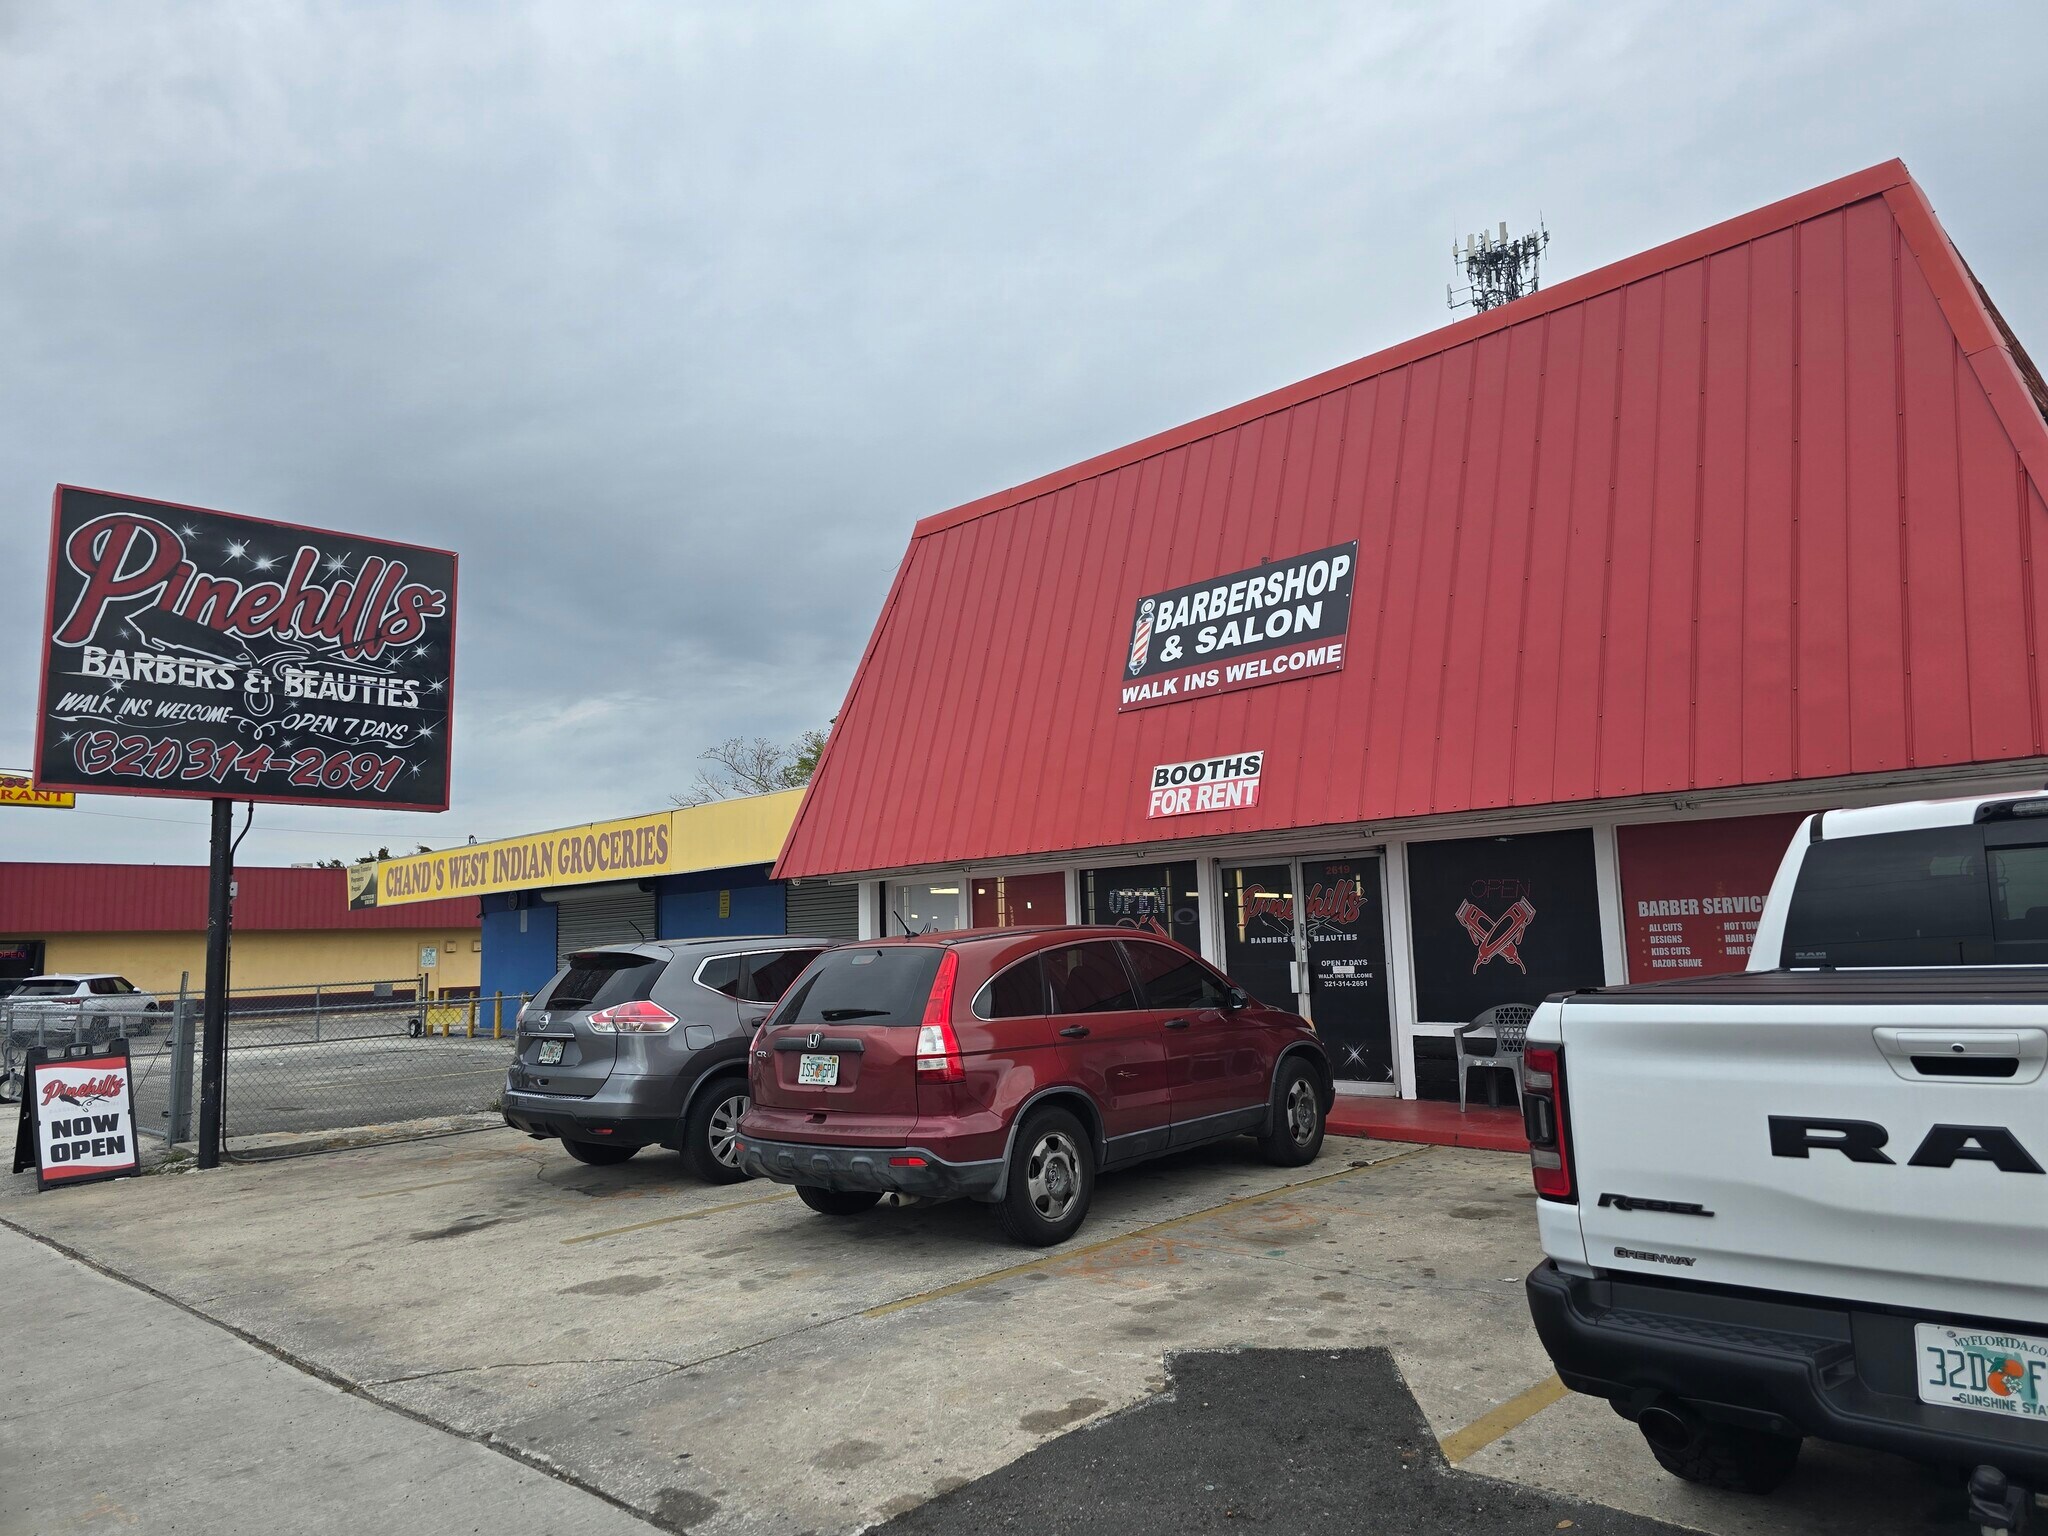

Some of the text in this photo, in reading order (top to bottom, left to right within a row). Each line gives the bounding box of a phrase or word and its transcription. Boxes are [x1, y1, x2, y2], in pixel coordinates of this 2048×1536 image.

[53, 512, 446, 661] Pinehills
[1155, 554, 1350, 634] BARBERSHOP
[1160, 601, 1323, 662] & SALON
[82, 645, 236, 690] BARBERS
[284, 668, 420, 708] BEAUTIES
[1122, 643, 1342, 704] WALK INS WELCOME
[55, 692, 234, 724] WALK INS WELCOME
[281, 713, 409, 740] OPEN 7 DAYS
[1154, 755, 1260, 788] BOOTHS
[1149, 778, 1259, 817] FOR RENT
[385, 823, 669, 898] CHAND'S WEST INDIAN GROCERIES
[1108, 886, 1167, 914] OPEN
[1471, 879, 1531, 898] OPEN
[1638, 898, 1699, 917] BARBER
[1313, 934, 1358, 942] BEAUTIES
[1649, 923, 1683, 932] ALL CUTS
[1723, 921, 1739, 931] HOT
[1725, 934, 1744, 943] HAIR
[1650, 935, 1682, 944] DESIGNS
[1651, 946, 1691, 956] KIDS CUTS
[1726, 946, 1745, 955] HAIR
[1652, 958, 1702, 968] RAZOR SHAVE
[41, 1074, 126, 1106] Pinehills
[51, 1113, 119, 1139] NOW
[50, 1135, 126, 1163] OPEN
[1597, 1192, 1715, 1217] REBEL
[1613, 1246, 1697, 1267] GREENWAY
[1953, 1335, 2048, 1358] MYFLORIDA.CO
[1958, 1393, 2017, 1412] SUNSHINE
